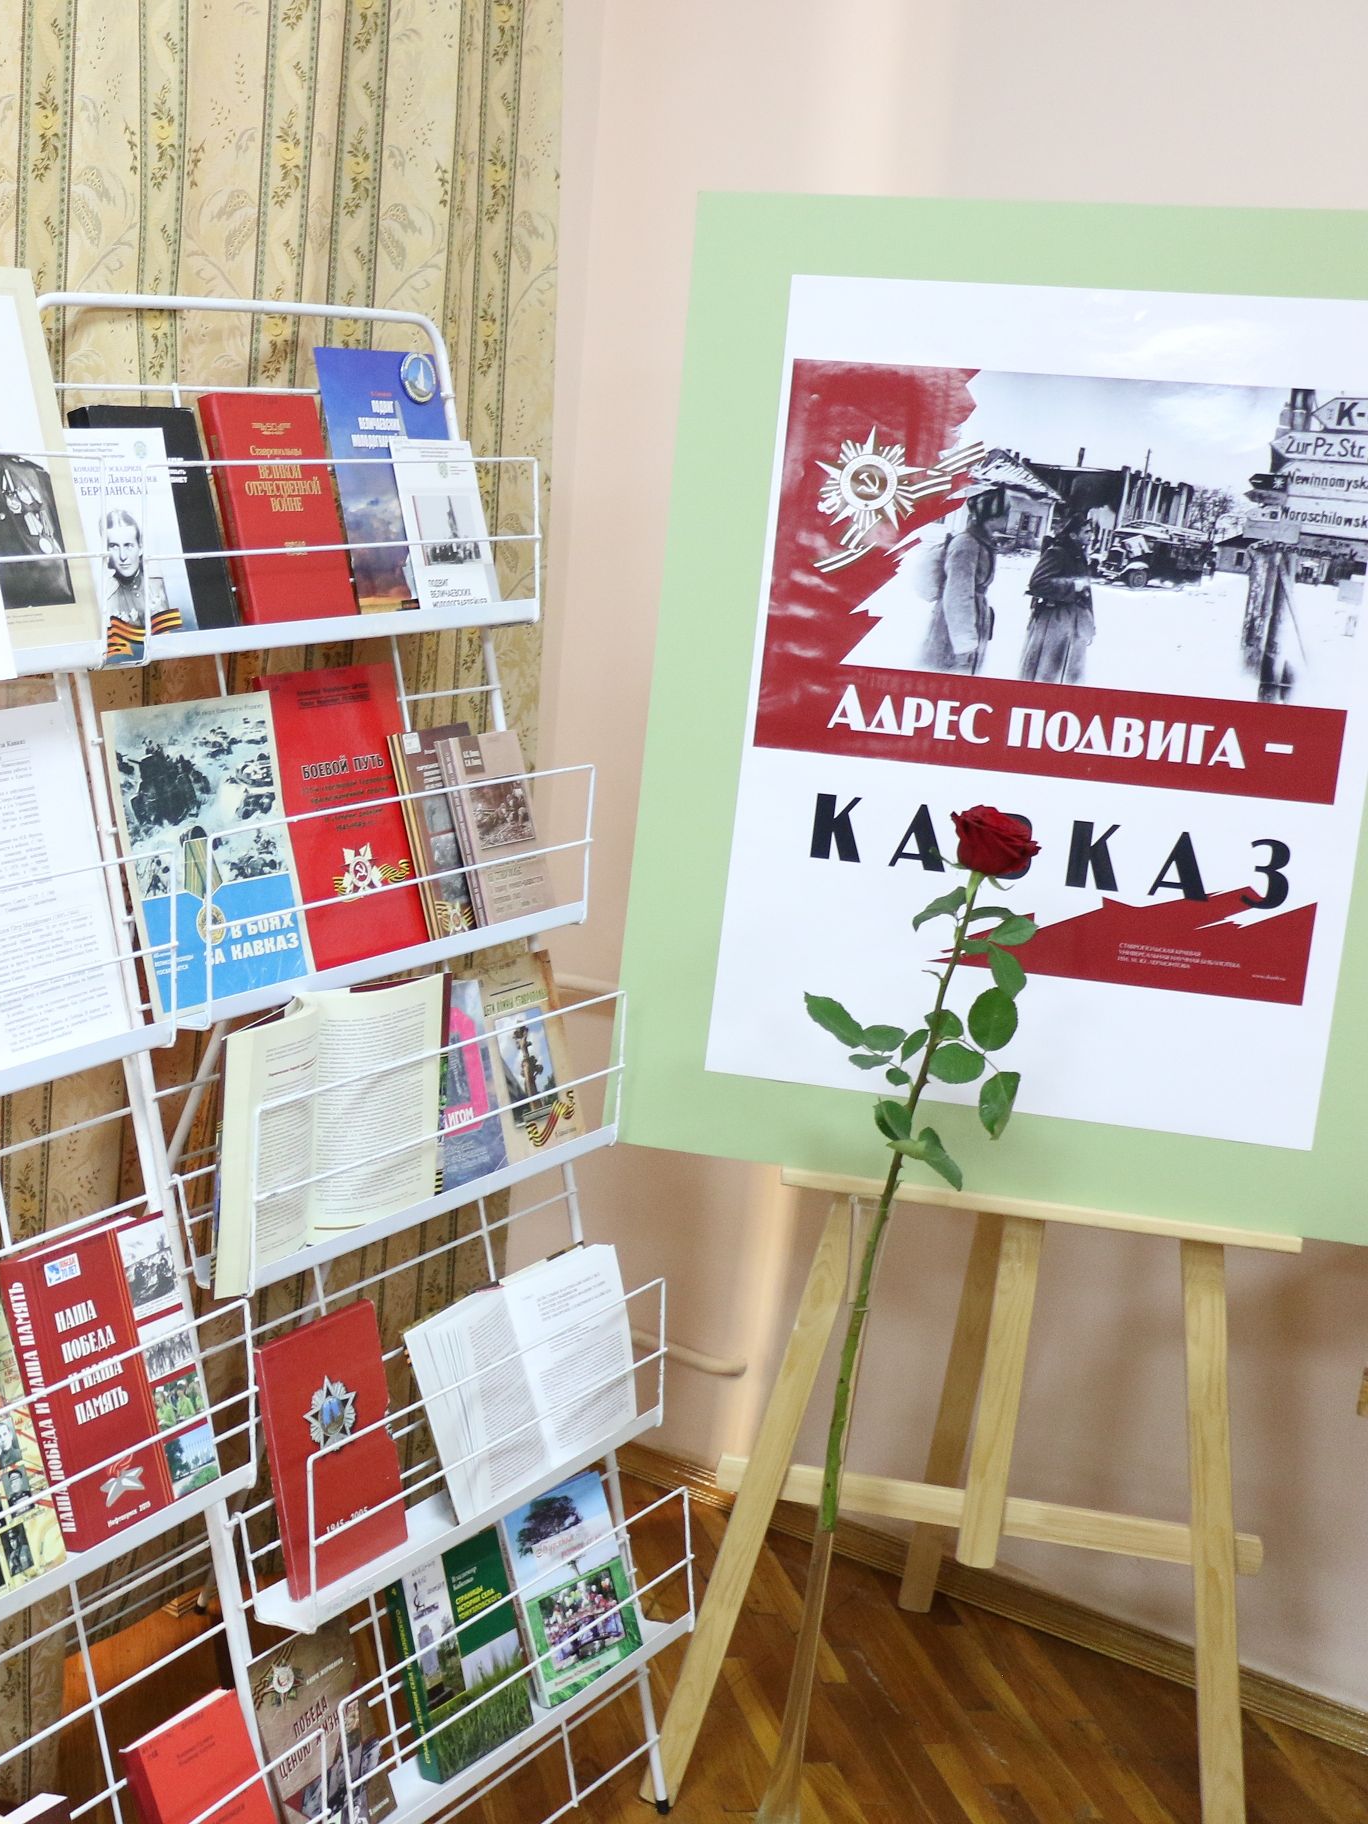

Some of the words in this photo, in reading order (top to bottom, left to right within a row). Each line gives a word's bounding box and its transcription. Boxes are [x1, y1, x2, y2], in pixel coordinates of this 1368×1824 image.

[244, 476, 322, 495] ОТЕЧЕСТВЕННОЙ
[826, 684, 993, 745] АДРЕС
[1007, 706, 1245, 770] ПОДВИГА
[301, 755, 349, 780] БОЕВОЙ
[353, 754, 385, 772] ПУТЬ
[810, 792, 1291, 910] КАКАЗ
[247, 912, 294, 936] БОЯХ
[231, 932, 300, 960] КАВКАЗ
[9, 1282, 36, 1346] ПАМЯТЬ
[54, 1299, 97, 1333] НАША
[61, 1325, 116, 1364] ПОБЕДА
[35, 1403, 50, 1414] И
[74, 1385, 129, 1425] ПАМЯТЬ
[39, 1418, 65, 1481] ПОБЕДА
[293, 1696, 329, 1739] ПОБЕДА
[279, 1743, 314, 1781] ЦЕНОЮ
